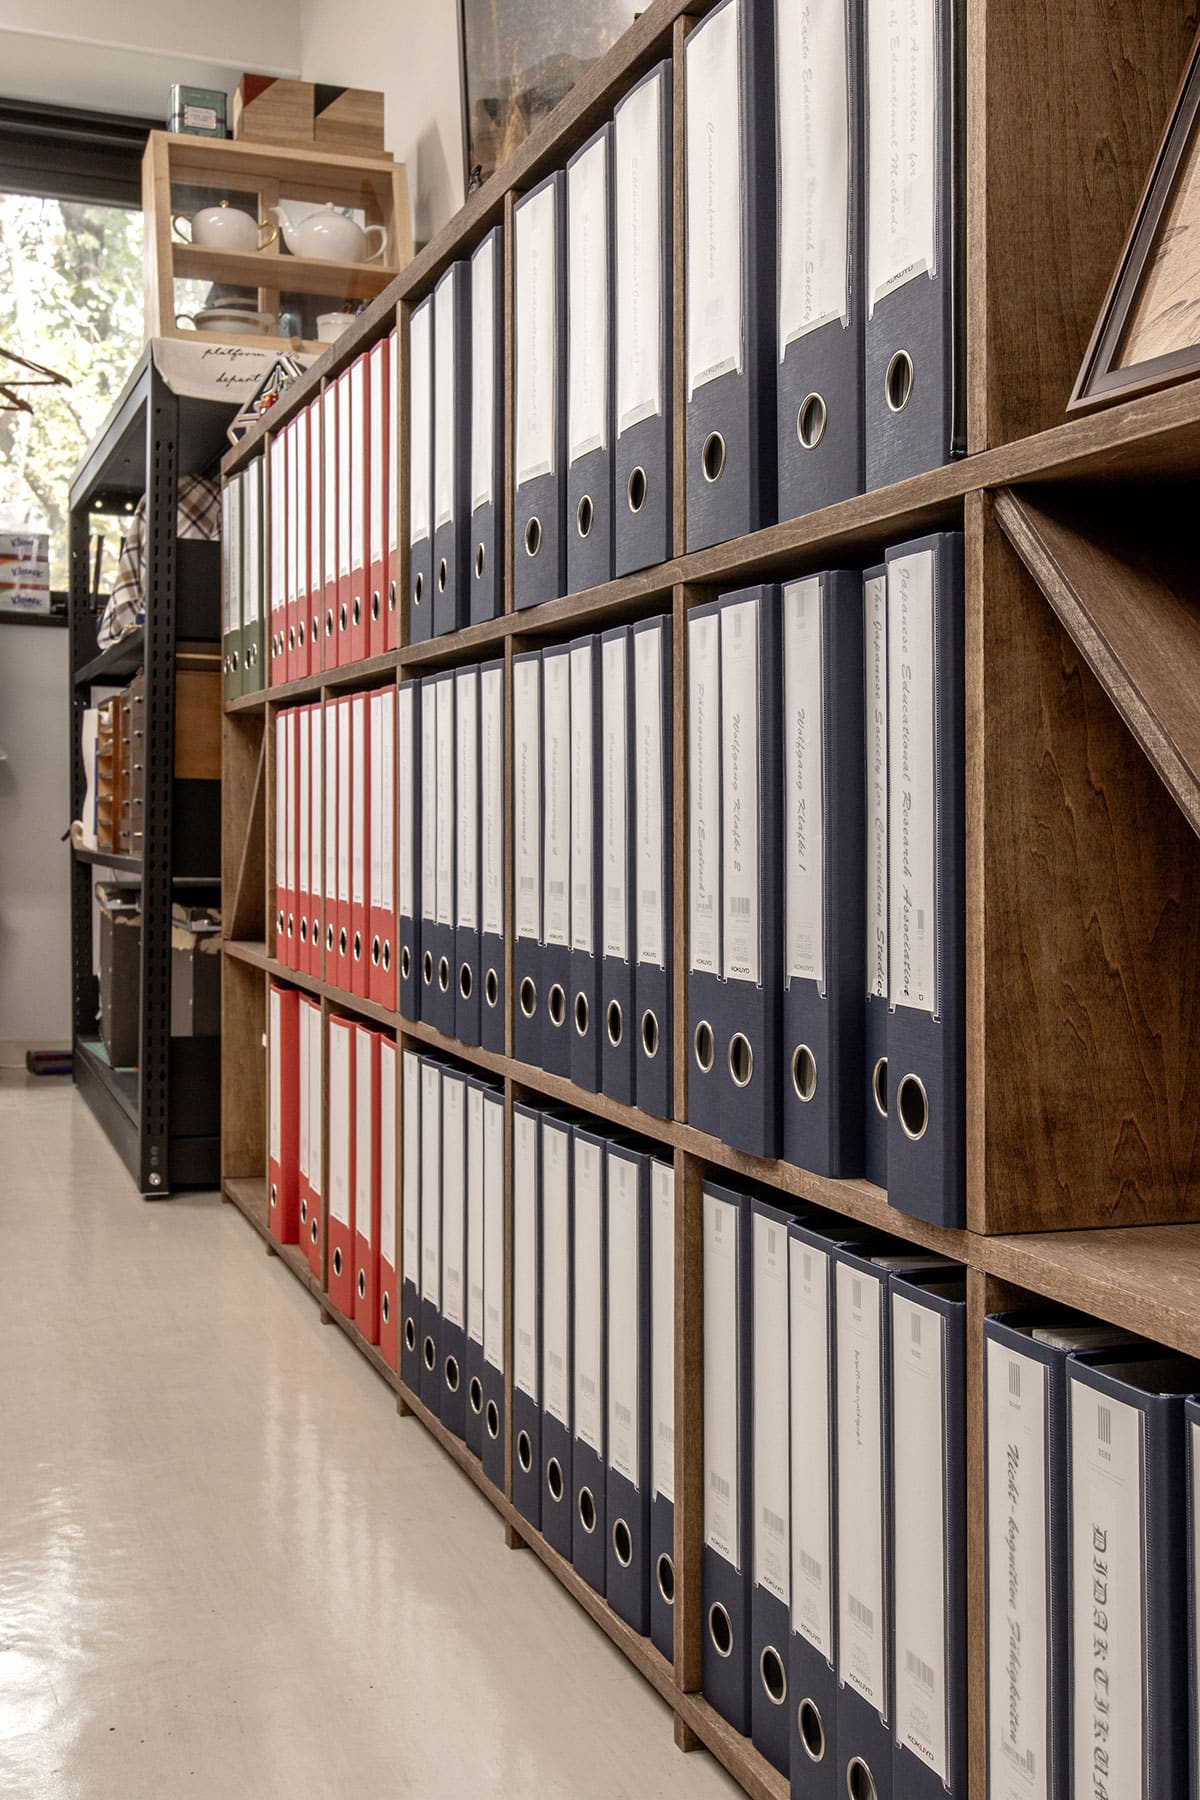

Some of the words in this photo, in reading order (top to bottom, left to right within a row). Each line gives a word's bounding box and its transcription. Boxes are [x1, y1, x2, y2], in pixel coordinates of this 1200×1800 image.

[889, 152, 899, 234] Methods
[803, 261, 815, 322] Society
[201, 346, 265, 361] platform
[215, 371, 261, 388] depart
[874, 578, 883, 613] The
[900, 568, 911, 654] Japanese
[873, 620, 883, 700] Japanese
[731, 712, 741, 792] Wolfgang
[796, 708, 806, 791] Wolfgang
[873, 708, 883, 777] Society
[901, 663, 912, 783] Educational
[731, 799, 741, 854] Klafki
[795, 799, 807, 857] Klafki
[874, 782, 884, 807] for
[875, 817, 884, 918] Curriculum
[902, 791, 912, 878] Research
[730, 965, 751, 975] KOKUYO
[876, 927, 885, 998] Studies
[903, 882, 912, 1001] Association
[849, 1671, 874, 1697] KOKUYO
[906, 1732, 935, 1762] KOKUYO
